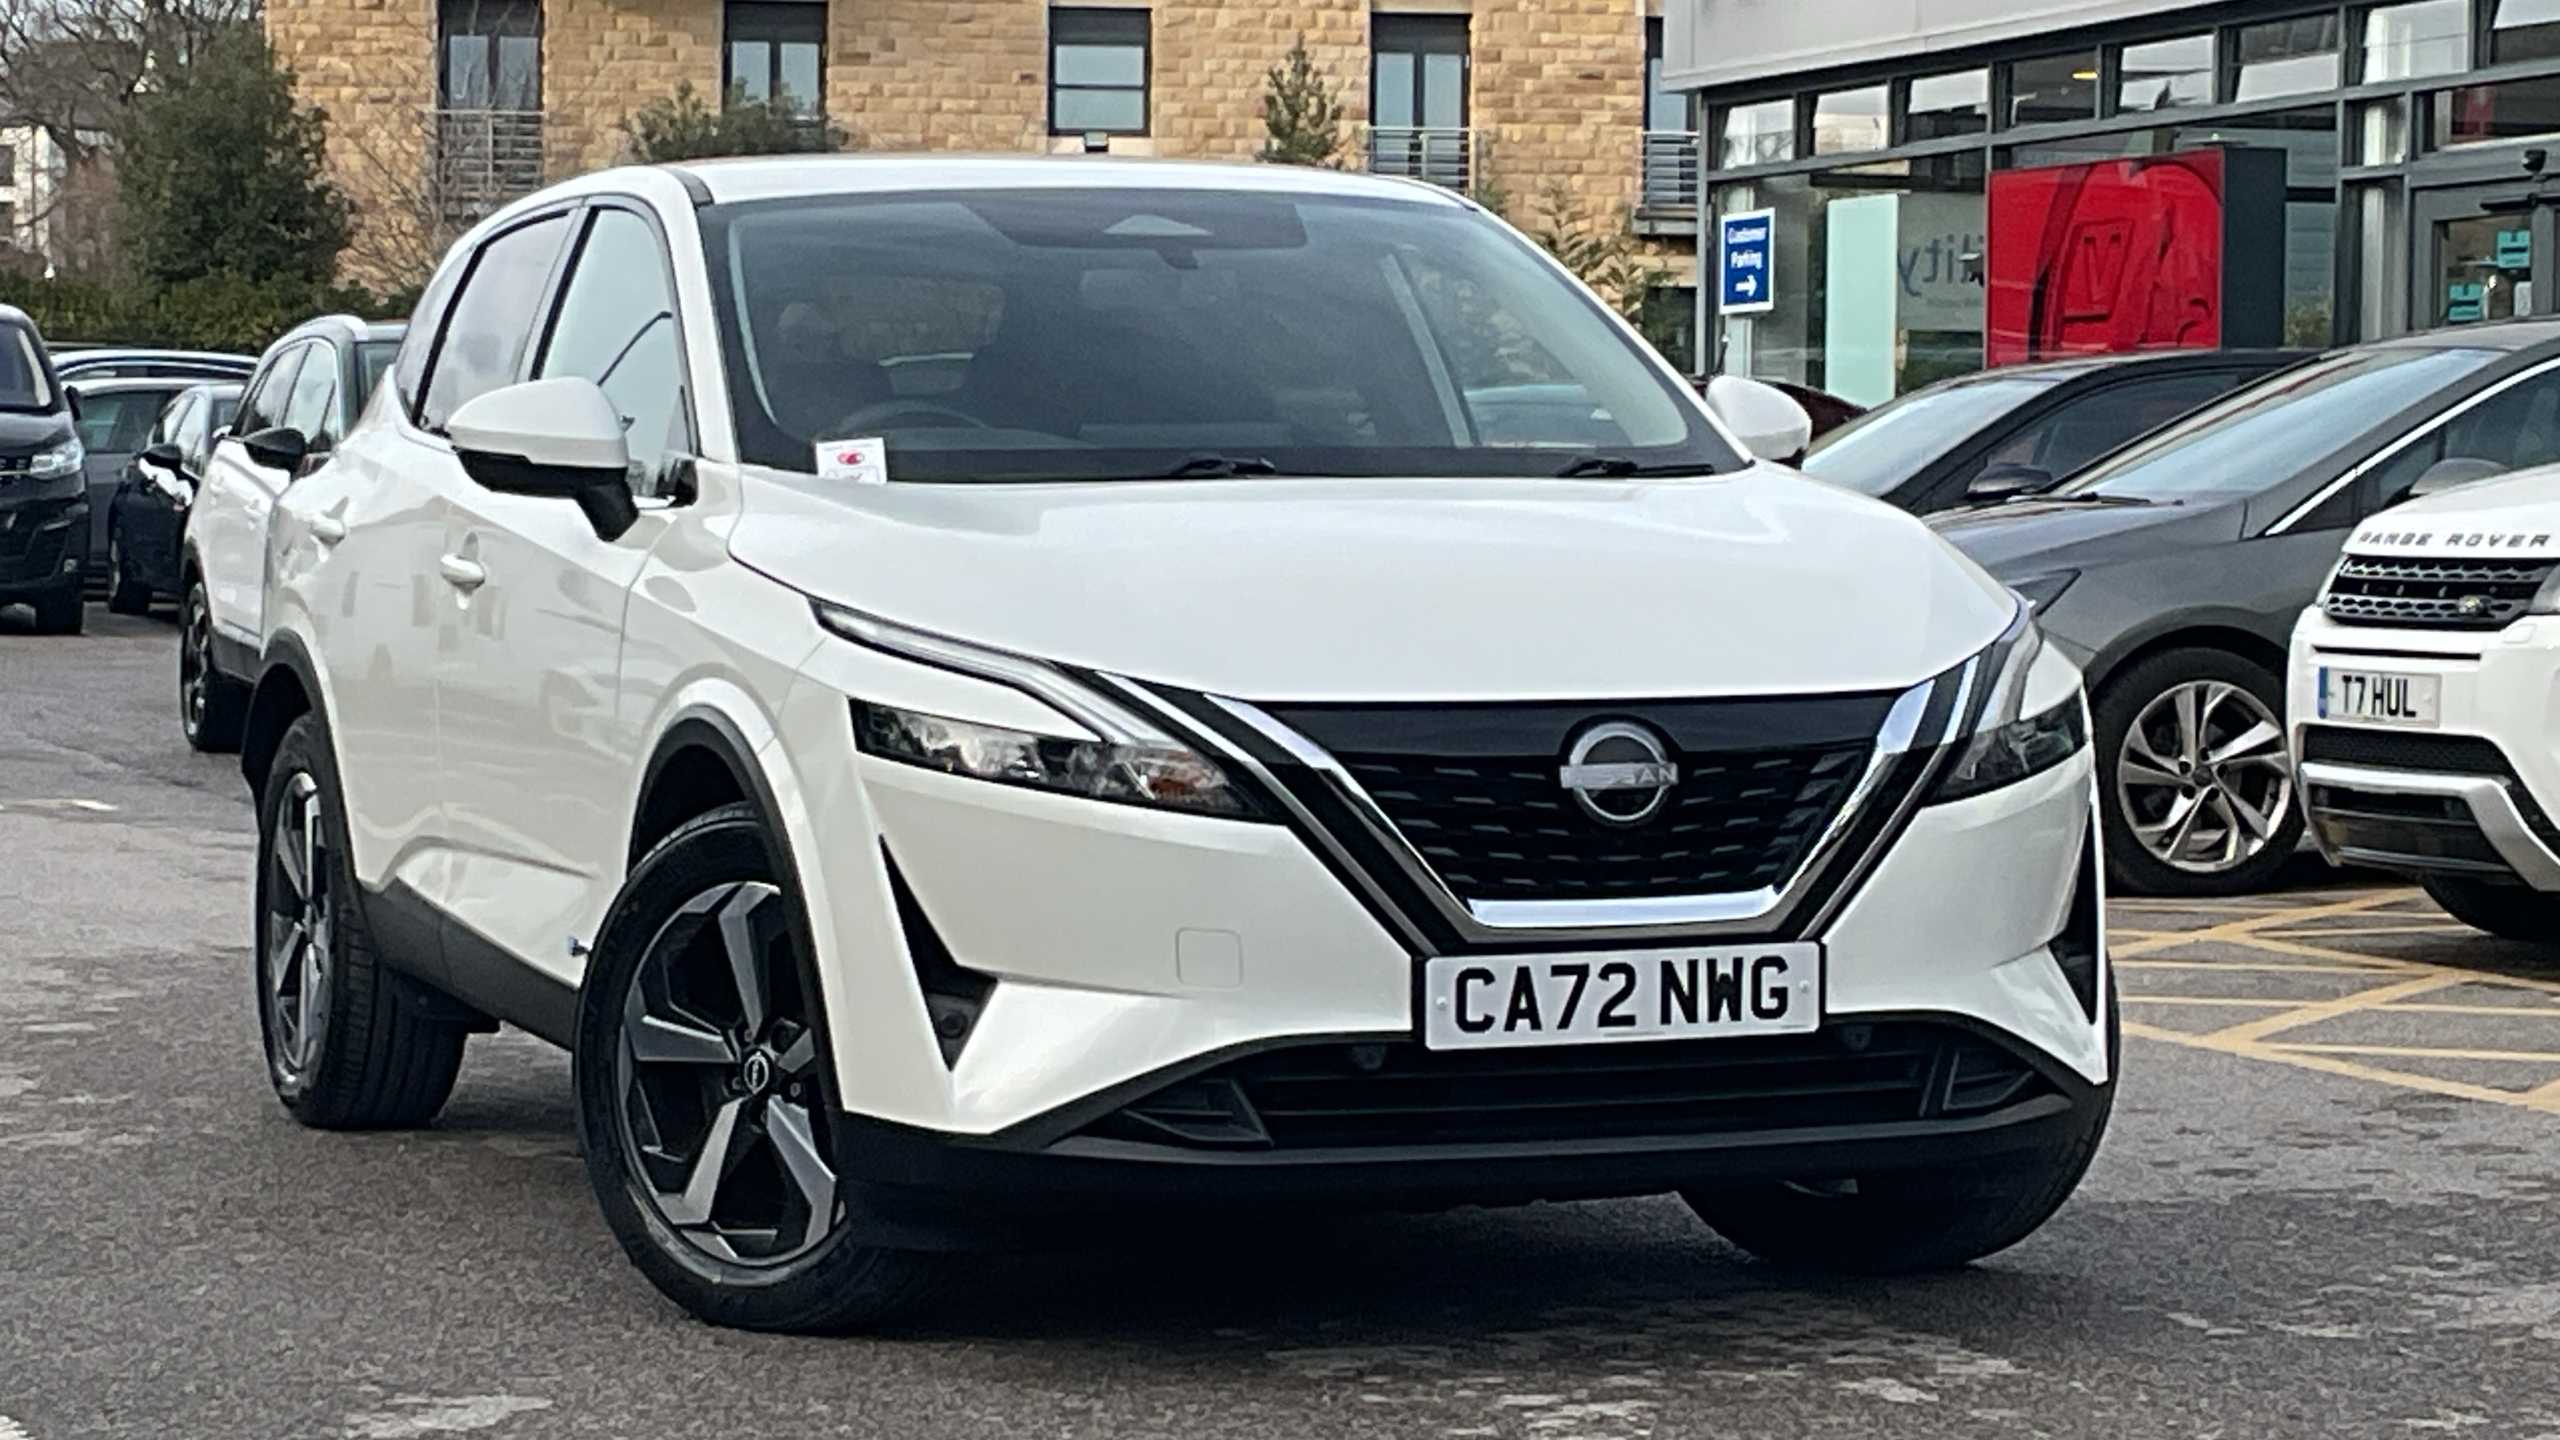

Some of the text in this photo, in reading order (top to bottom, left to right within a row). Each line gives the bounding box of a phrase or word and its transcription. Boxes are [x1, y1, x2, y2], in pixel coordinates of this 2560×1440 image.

[1730, 249, 1762, 270] Parking
[2359, 531, 2551, 547] RANGE ROVER
[2341, 675, 2417, 718] T7 HUL
[1454, 955, 1789, 1034] CA72 NWG
